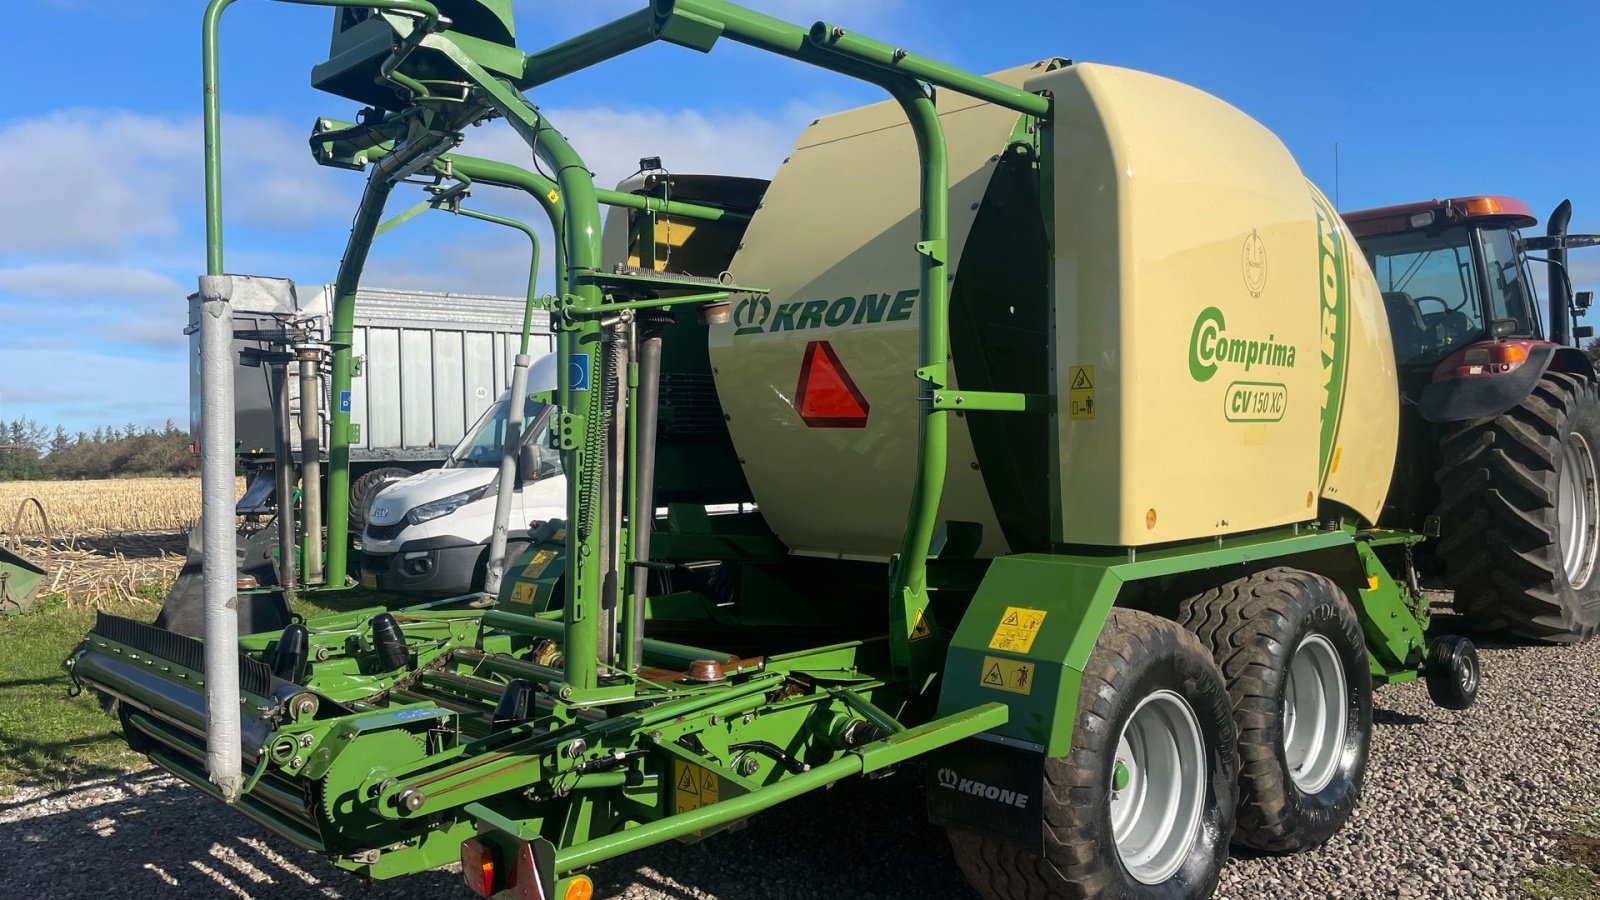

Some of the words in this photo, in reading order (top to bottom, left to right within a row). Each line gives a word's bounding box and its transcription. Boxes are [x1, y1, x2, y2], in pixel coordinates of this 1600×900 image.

[769, 289, 920, 333] KRONE
[1200, 325, 1296, 372] Comprima
[1231, 390, 1252, 414] CV
[1252, 391, 1270, 414] 150
[1269, 391, 1283, 414] XC
[958, 778, 1029, 809] KRONE
